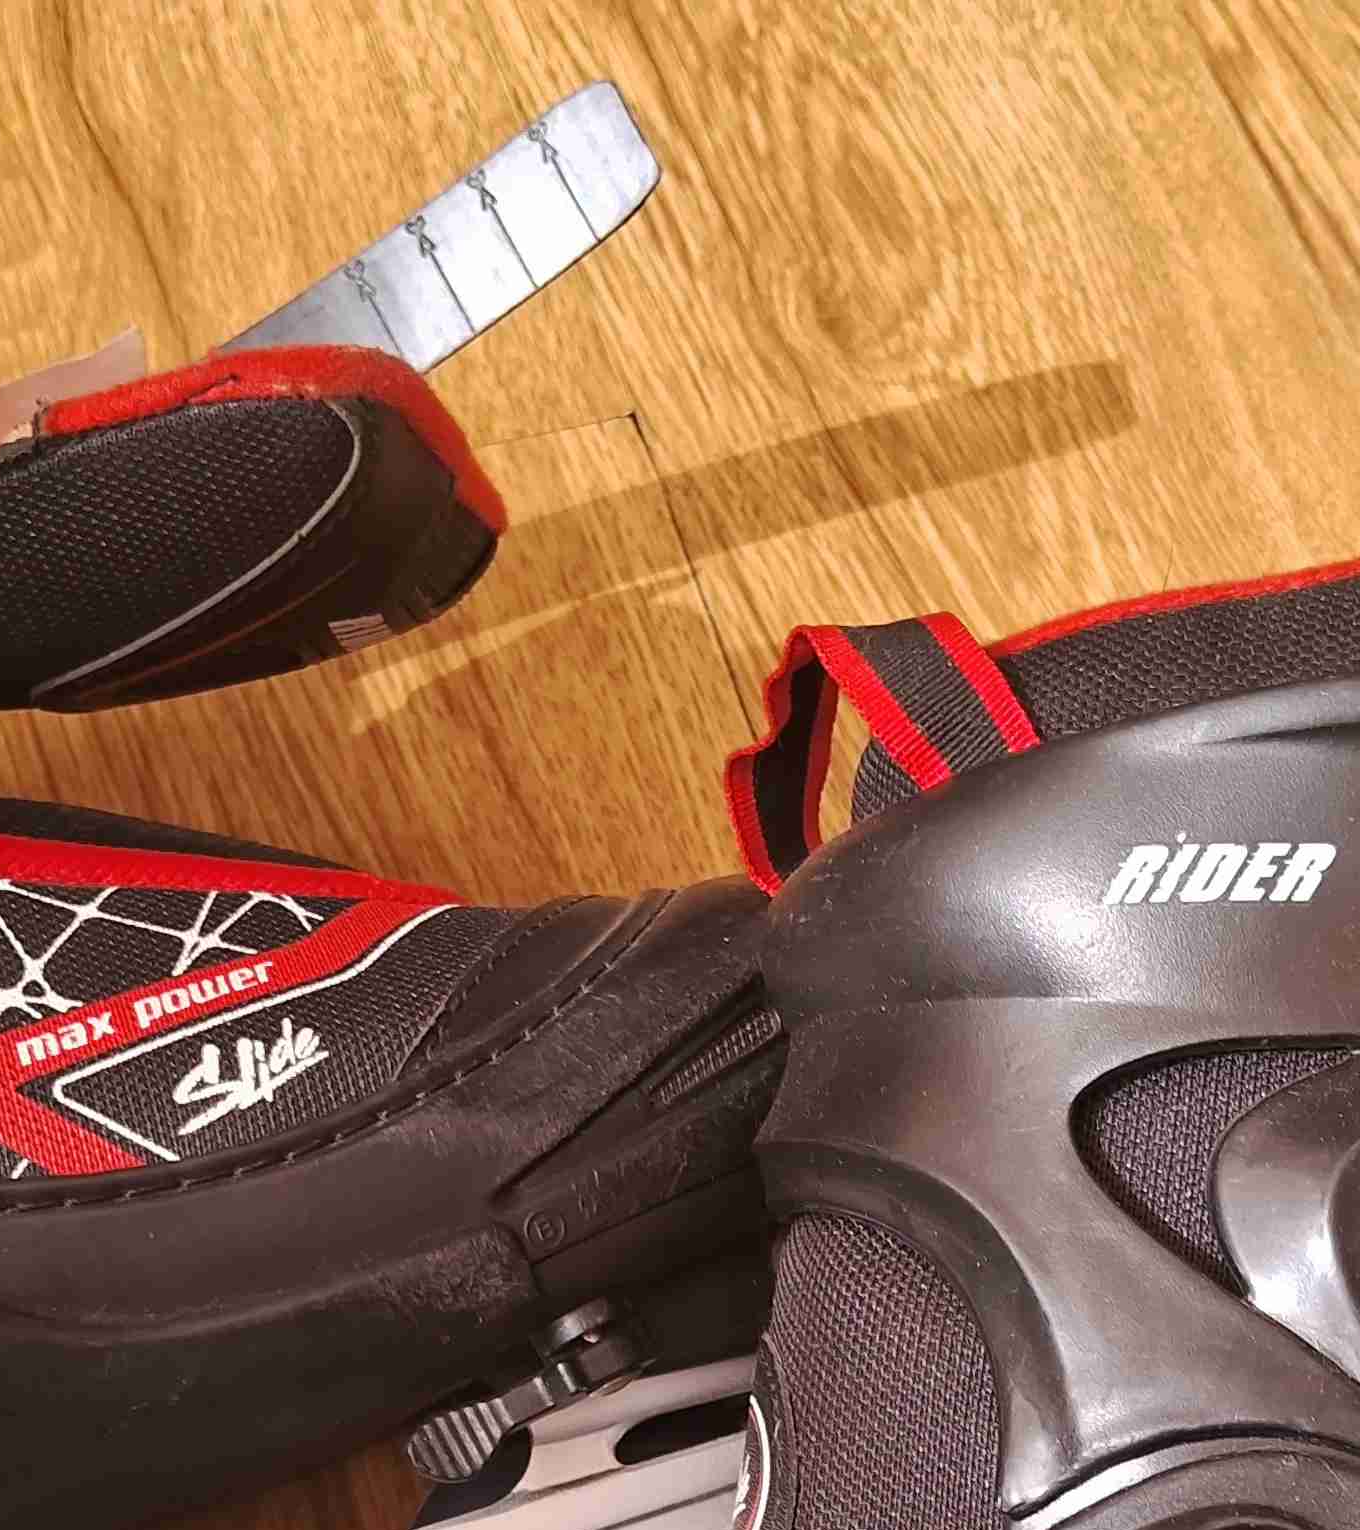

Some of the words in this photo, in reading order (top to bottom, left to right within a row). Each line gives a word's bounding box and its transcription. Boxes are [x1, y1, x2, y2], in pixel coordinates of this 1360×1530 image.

[1103, 832, 1337, 905] RIDER
[16, 1011, 114, 1067] max
[134, 961, 273, 1029] power
[173, 1018, 330, 1136] Slide
